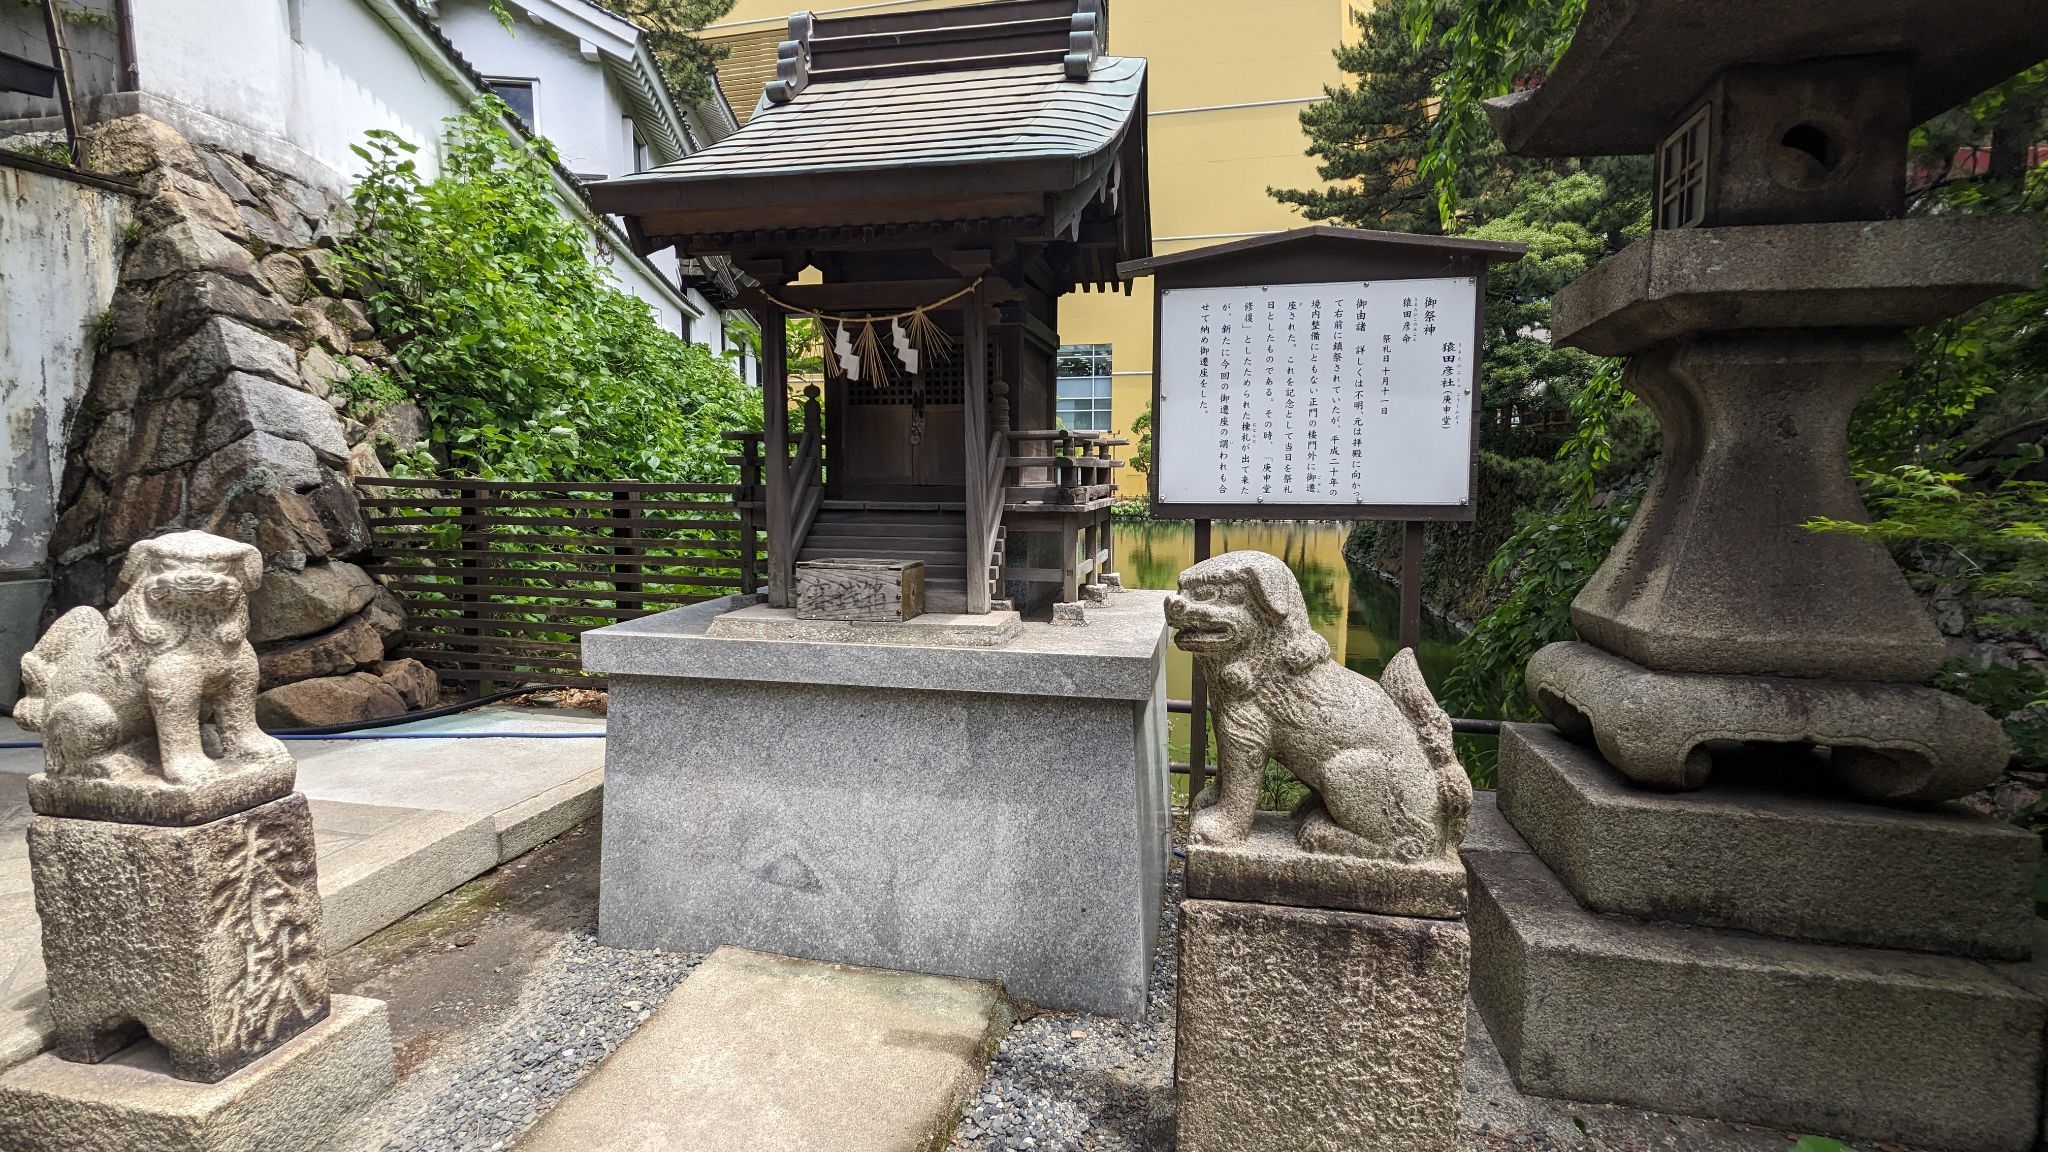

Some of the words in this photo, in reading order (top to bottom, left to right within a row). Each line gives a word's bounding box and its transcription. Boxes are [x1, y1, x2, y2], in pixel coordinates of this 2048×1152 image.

[1402, 296, 1412, 345] 猿田彦命
[1423, 296, 1438, 337] 御祭神
